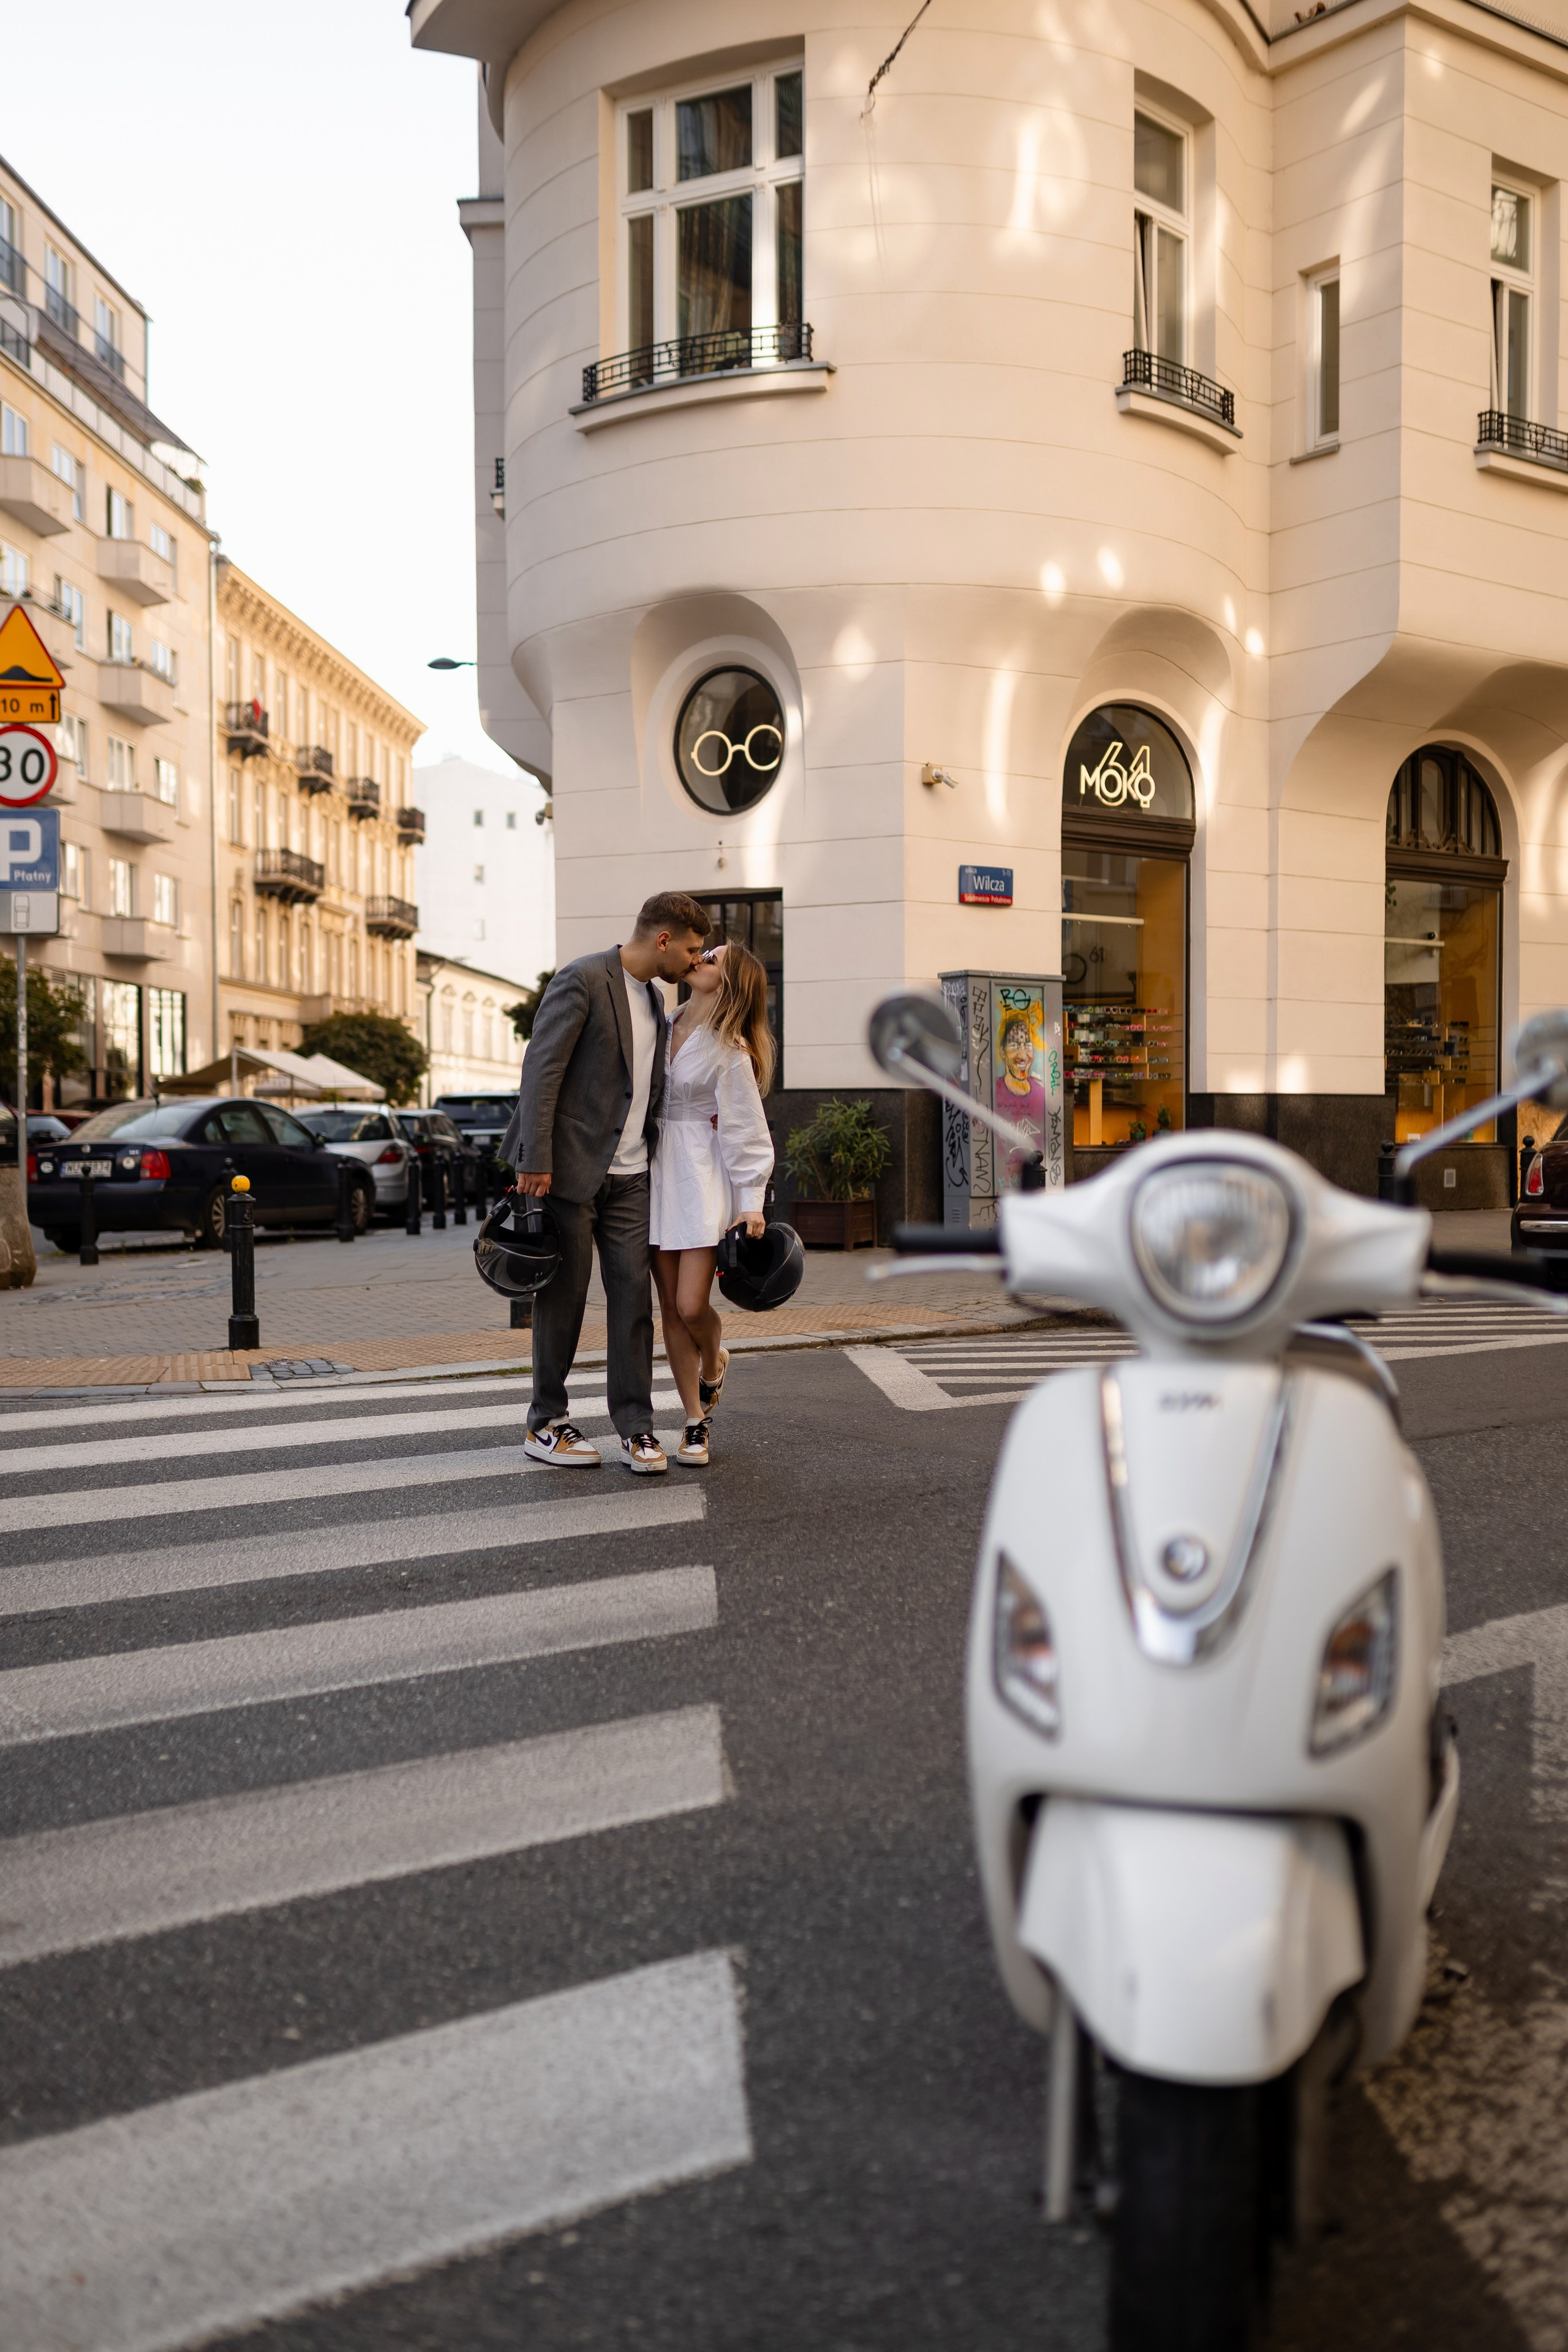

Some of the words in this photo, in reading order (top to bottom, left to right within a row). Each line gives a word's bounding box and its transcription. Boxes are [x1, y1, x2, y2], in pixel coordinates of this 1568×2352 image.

[30, 703, 44, 712] m
[1080, 763, 1156, 801] MOKO
[0, 818, 42, 881] P
[973, 875, 1005, 892] Wilcza
